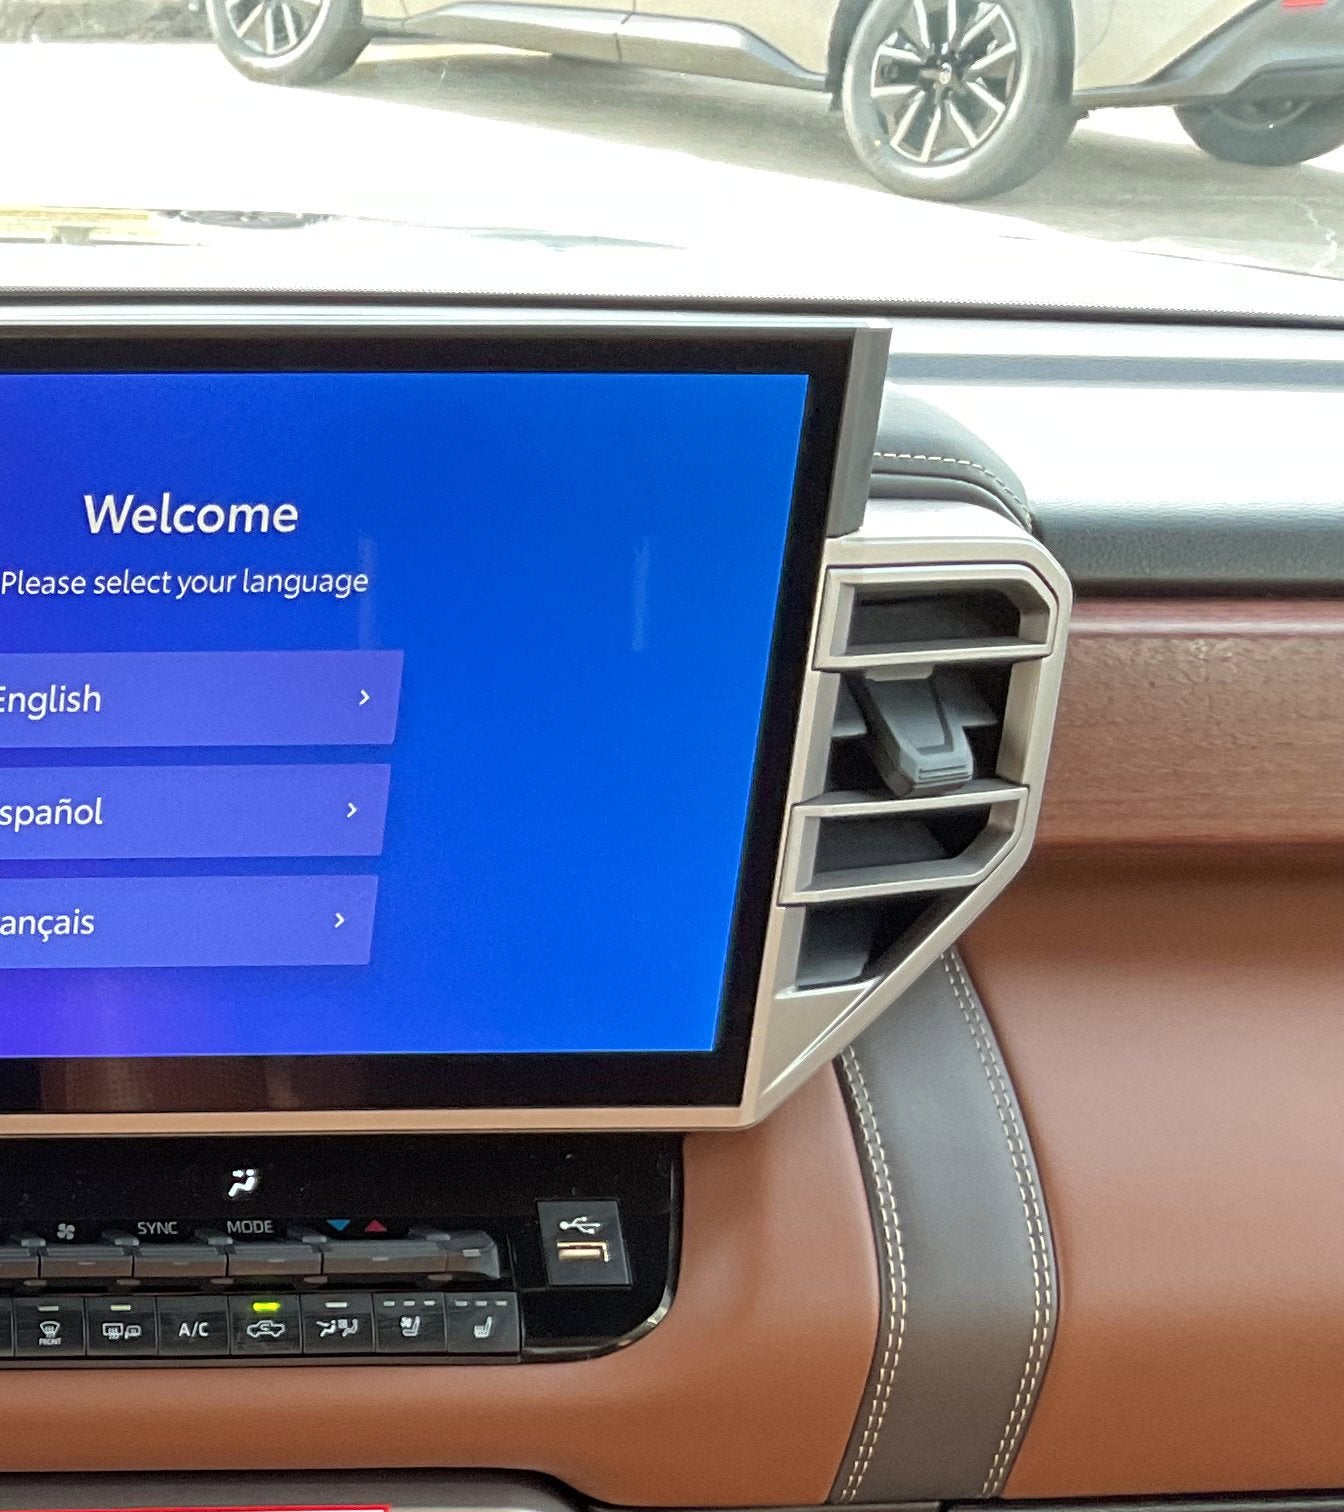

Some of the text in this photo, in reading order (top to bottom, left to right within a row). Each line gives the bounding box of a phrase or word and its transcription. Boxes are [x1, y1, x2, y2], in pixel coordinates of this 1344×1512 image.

[83, 491, 299, 535] Welcome
[0, 567, 369, 600] Please select your language
[137, 1220, 179, 1236] SYNC
[227, 1219, 273, 1235] MODE
[178, 1321, 210, 1338] A/C
